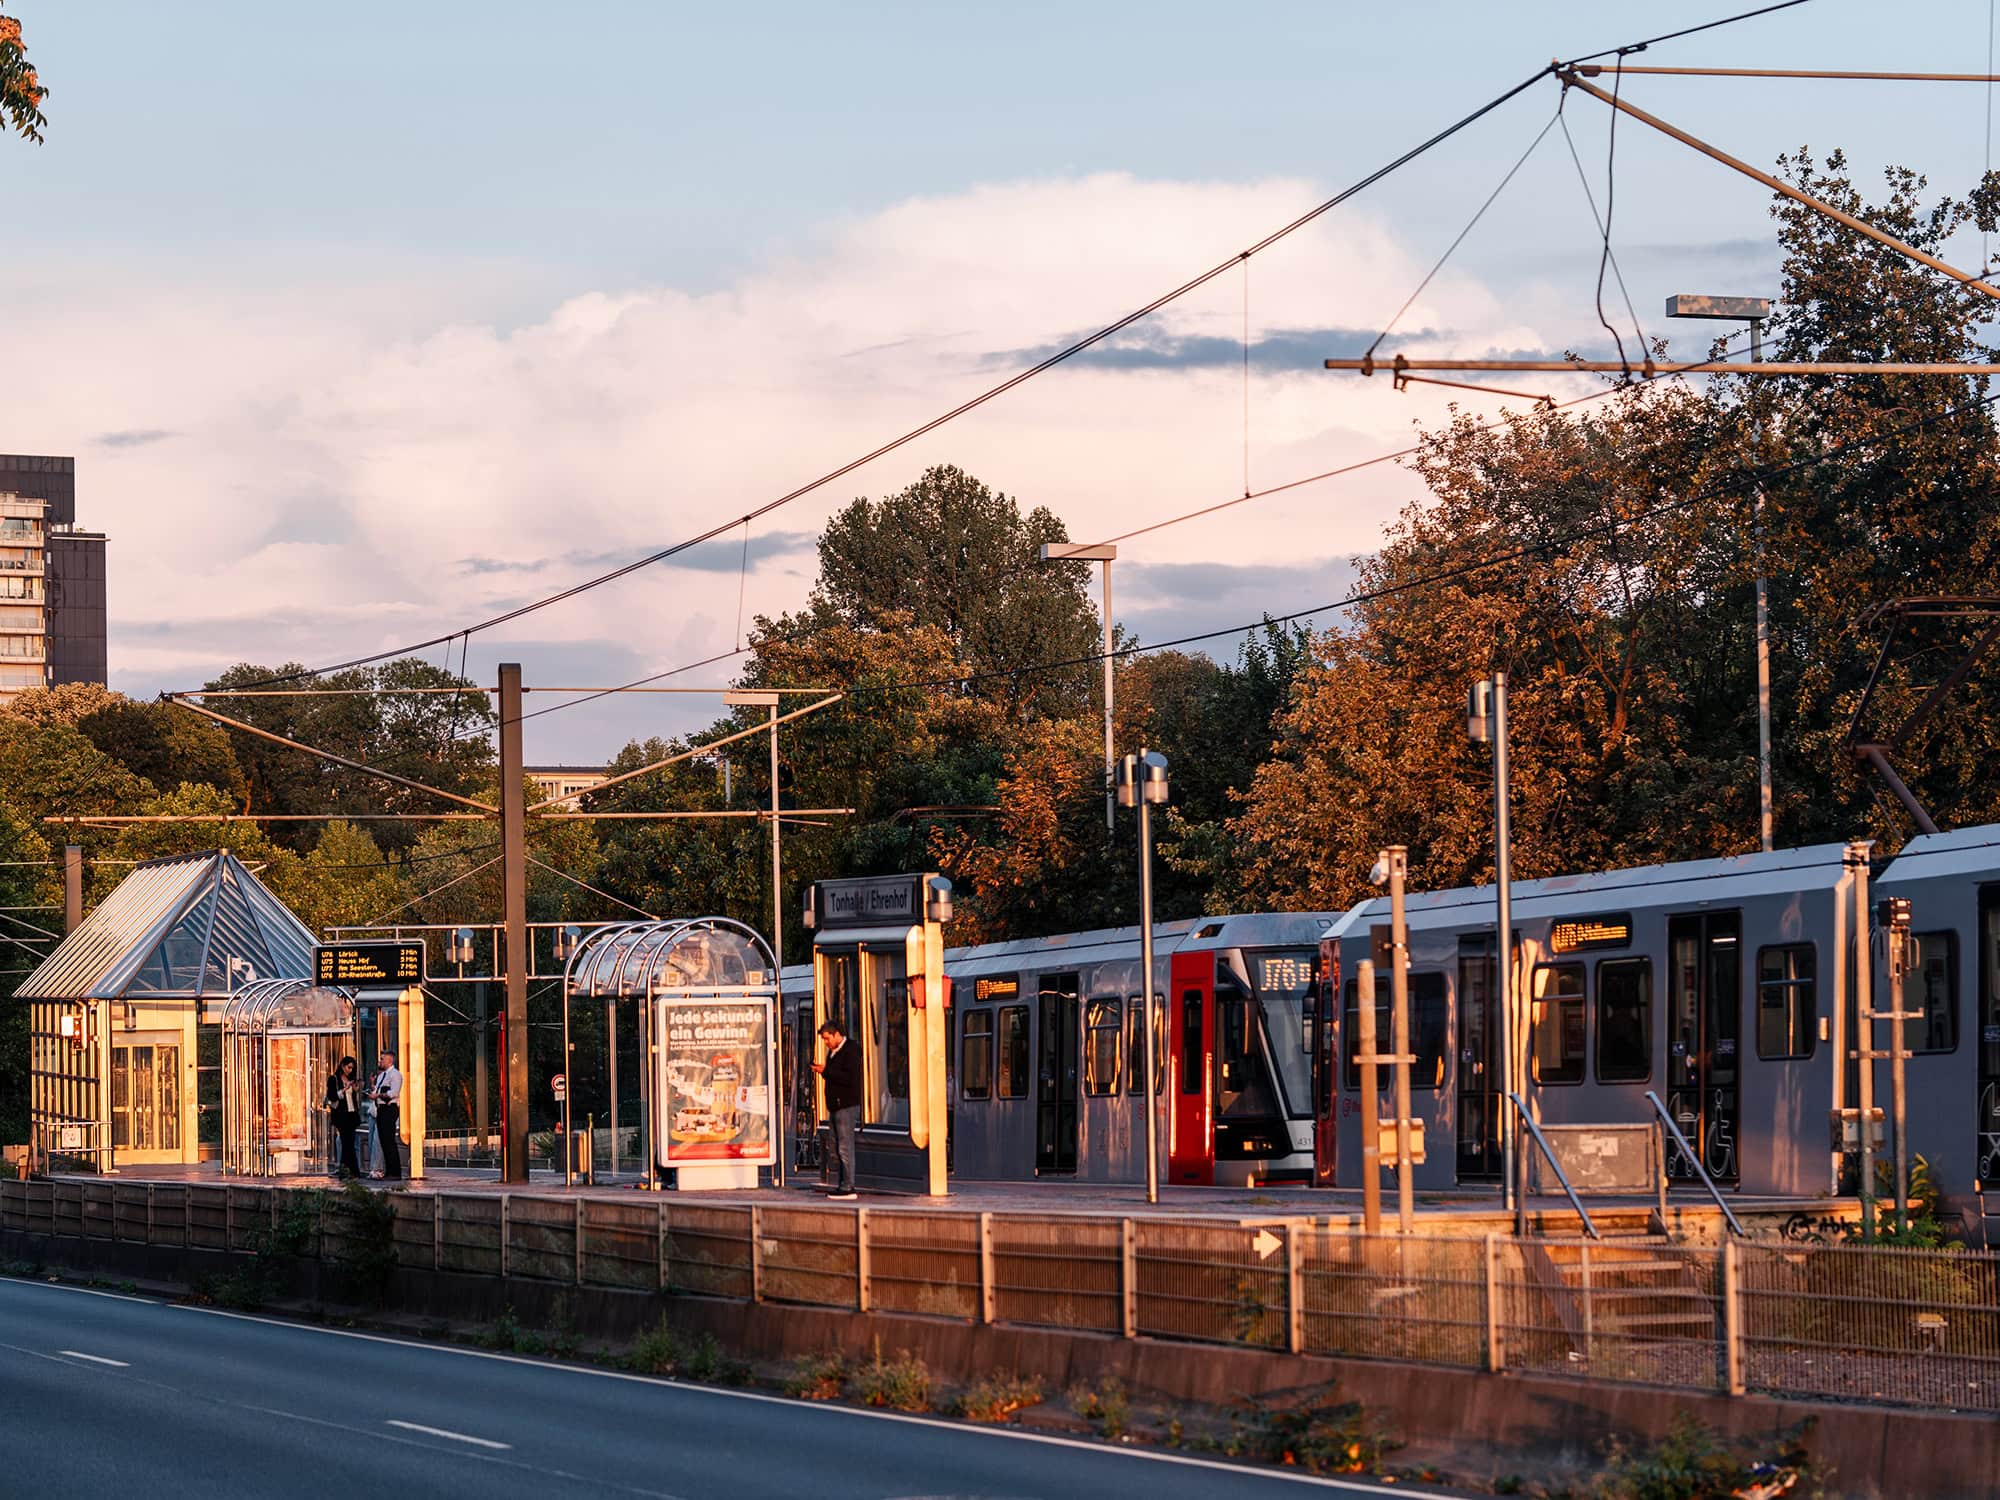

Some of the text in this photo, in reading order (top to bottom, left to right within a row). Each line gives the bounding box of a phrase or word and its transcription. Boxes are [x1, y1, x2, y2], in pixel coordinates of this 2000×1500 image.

[871, 889, 907, 909] Ehrenhof
[670, 1009, 762, 1024] Jede Sekunde
[670, 1027, 692, 1039] ein
